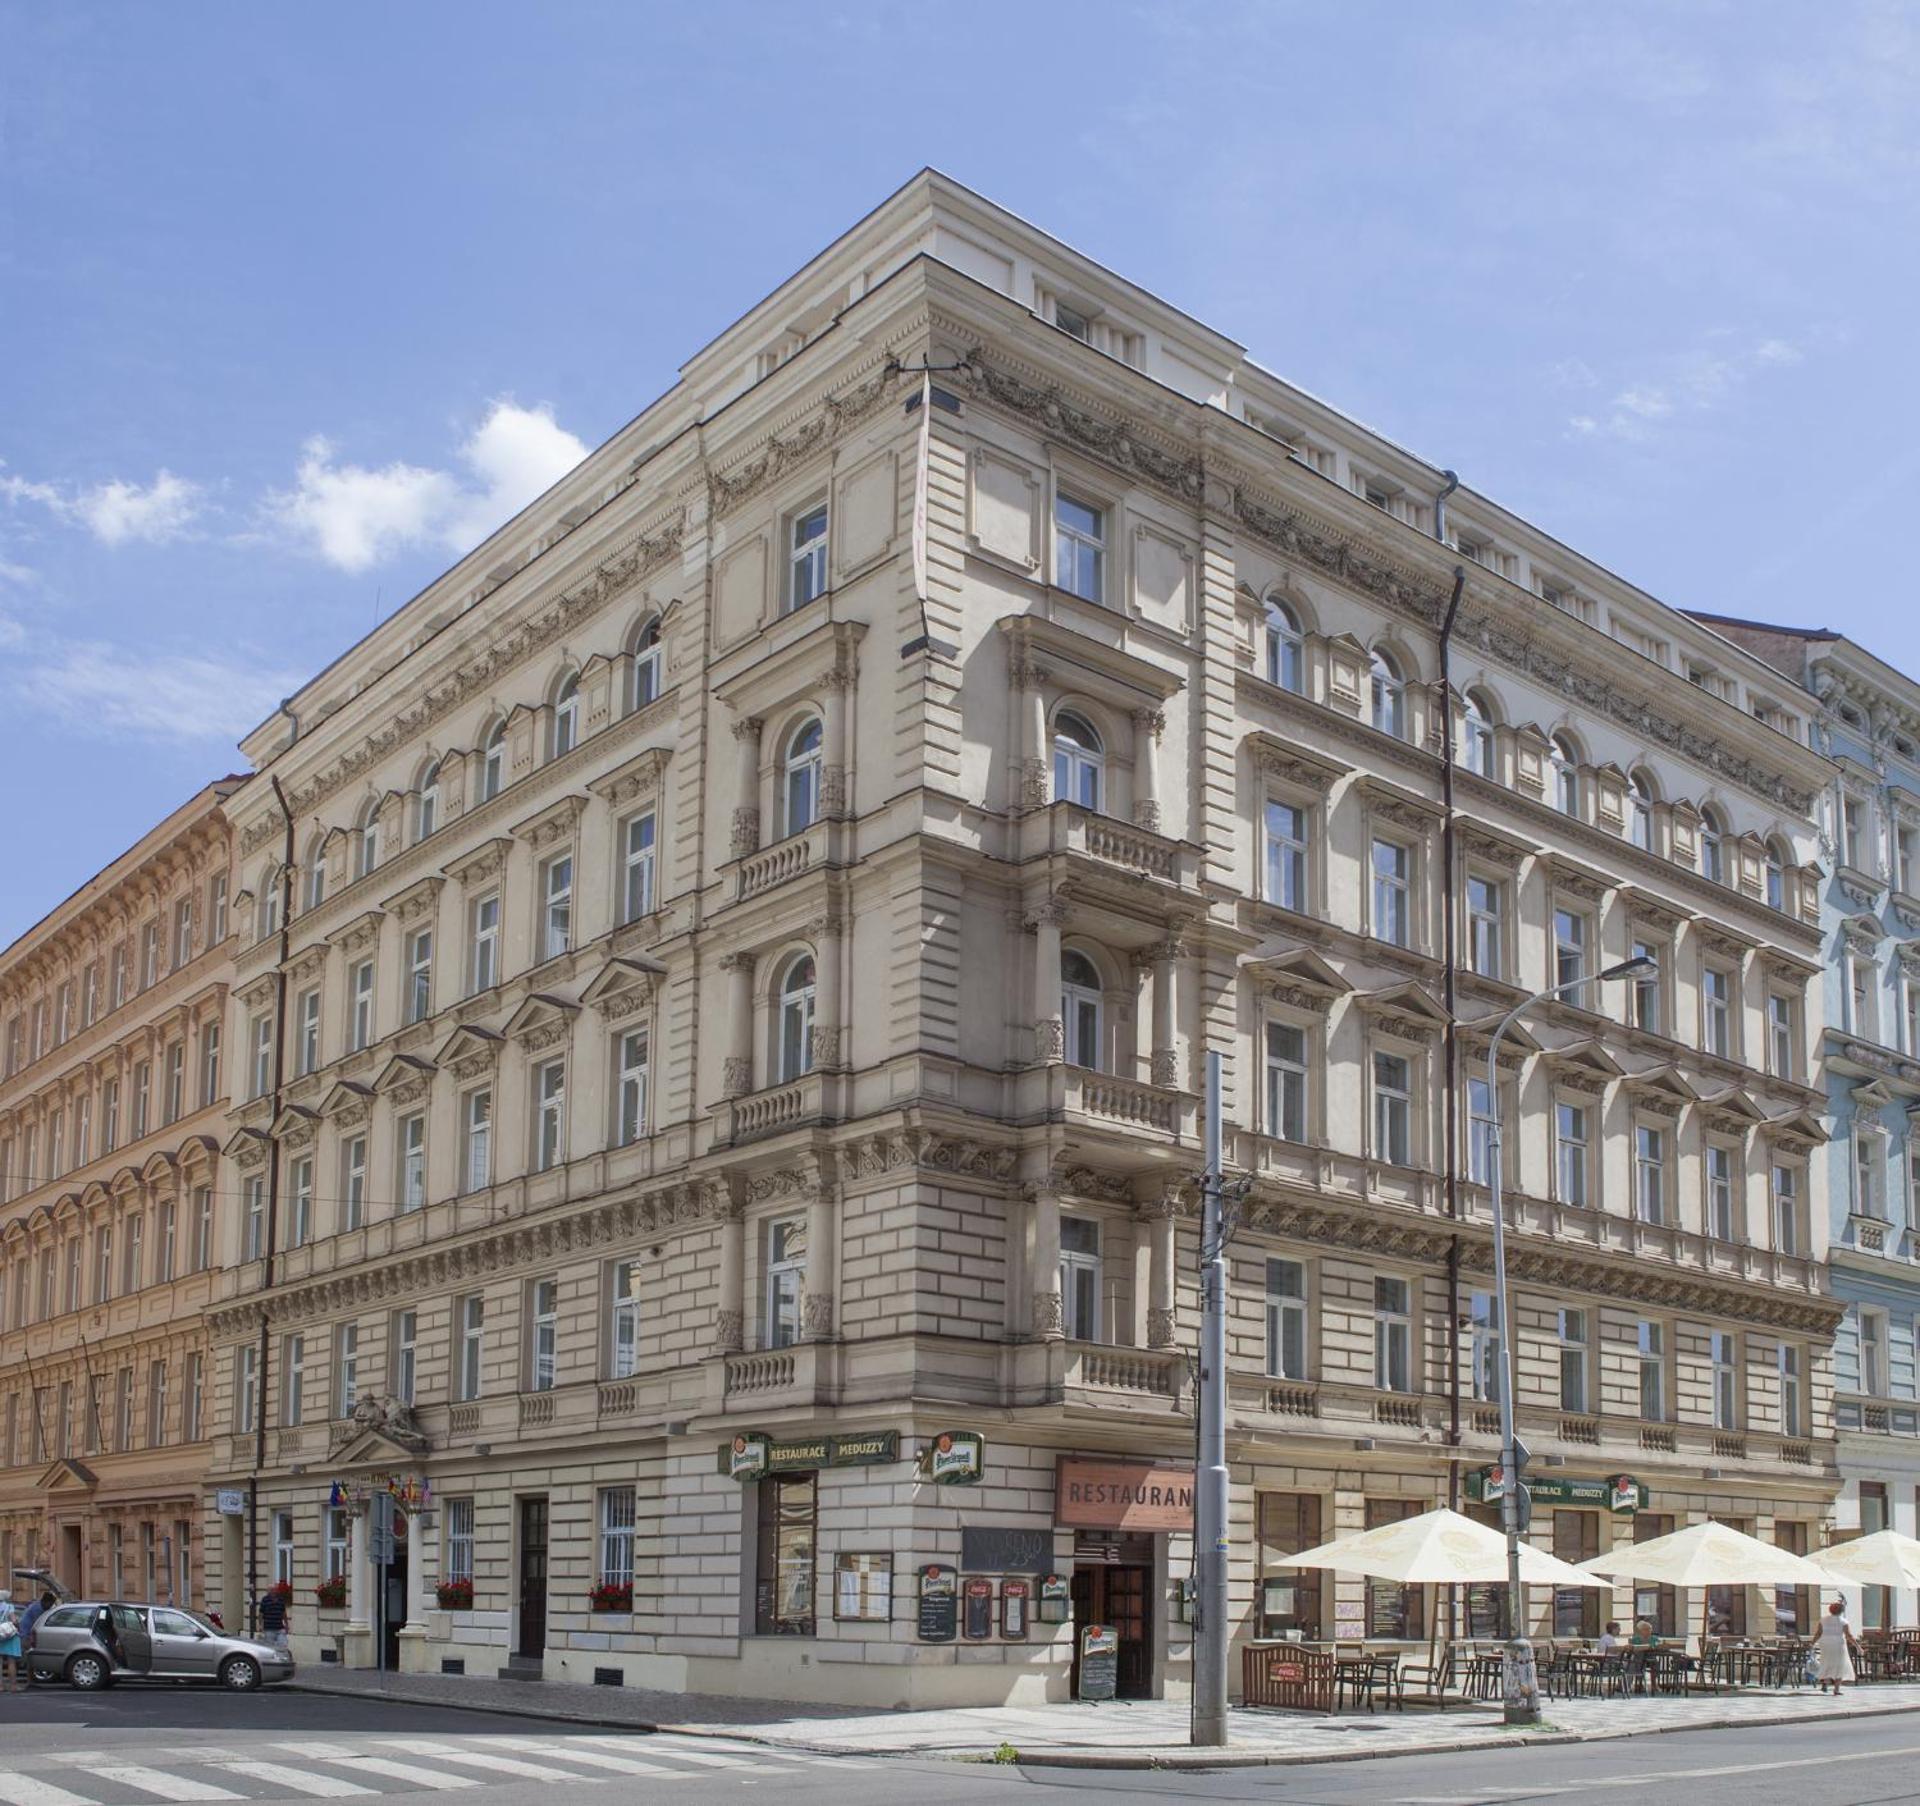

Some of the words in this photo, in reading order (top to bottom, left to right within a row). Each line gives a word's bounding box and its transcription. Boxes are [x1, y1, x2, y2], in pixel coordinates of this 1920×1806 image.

[770, 1446, 826, 1461] RESTAURACE
[838, 1441, 884, 1457] MEDUZZY
[1069, 1482, 1192, 1508] RESTAURAN
